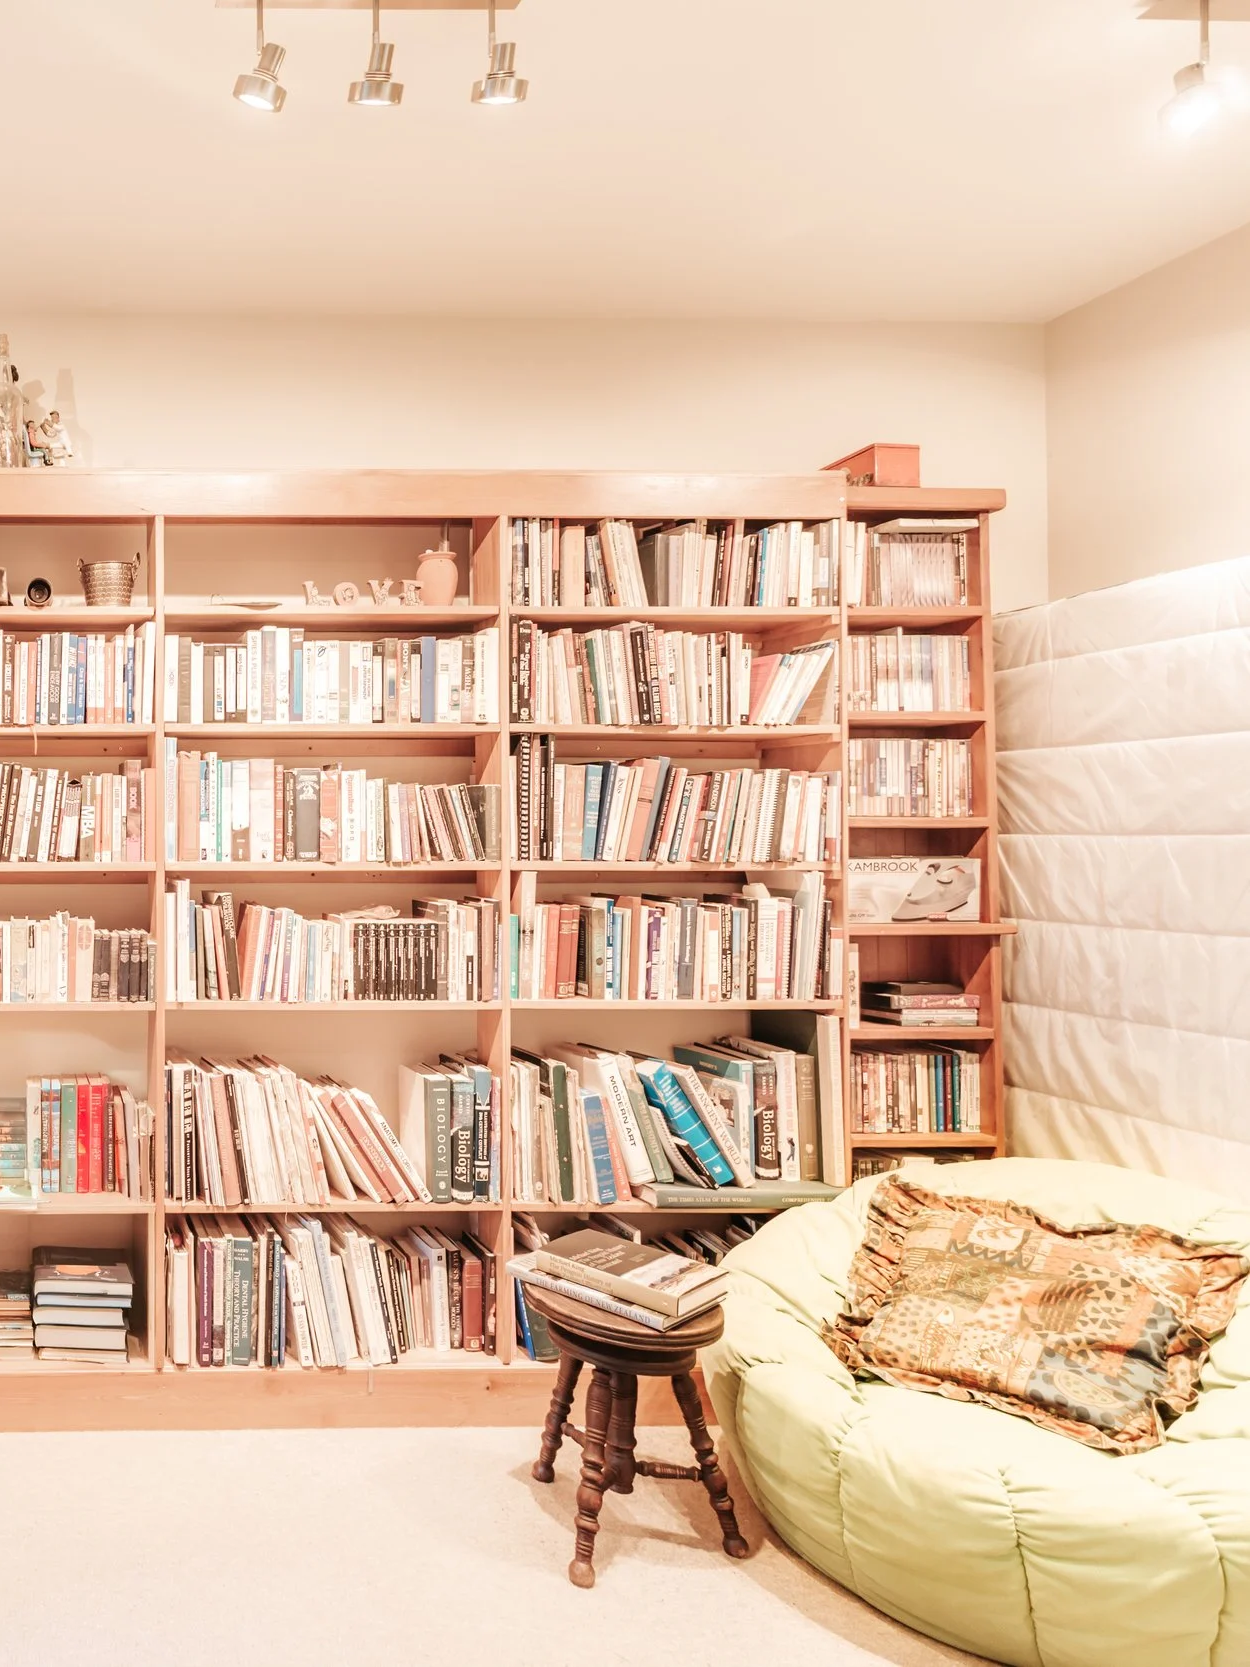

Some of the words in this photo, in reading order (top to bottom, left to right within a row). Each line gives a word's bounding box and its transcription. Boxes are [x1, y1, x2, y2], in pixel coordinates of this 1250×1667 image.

[684, 780, 694, 798] blink
[710, 782, 720, 810] HENDERSON
[81, 806, 94, 838] MBA
[677, 806, 686, 828] MALCOLM
[673, 829, 682, 853] GLADWELL
[848, 862, 918, 872] KAMBROOK
[610, 1075, 628, 1125] MODERN
[624, 1127, 636, 1148] ART
[687, 1072, 703, 1094] THE
[698, 1094, 724, 1133] ANCIENT
[718, 1133, 742, 1166] WORLD
[380, 1121, 398, 1148] ANATOMY
[436, 1098, 446, 1162] BIOLOGY
[760, 1110, 776, 1160] Biology
[454, 1130, 470, 1182] Biology
[536, 1277, 549, 1288] THE
[549, 1280, 584, 1300] FARMING
[584, 1295, 596, 1304] OF
[595, 1298, 614, 1310] NEW
[614, 1304, 651, 1324] ZEALAND
[296, 1314, 304, 1330] SUSAN
